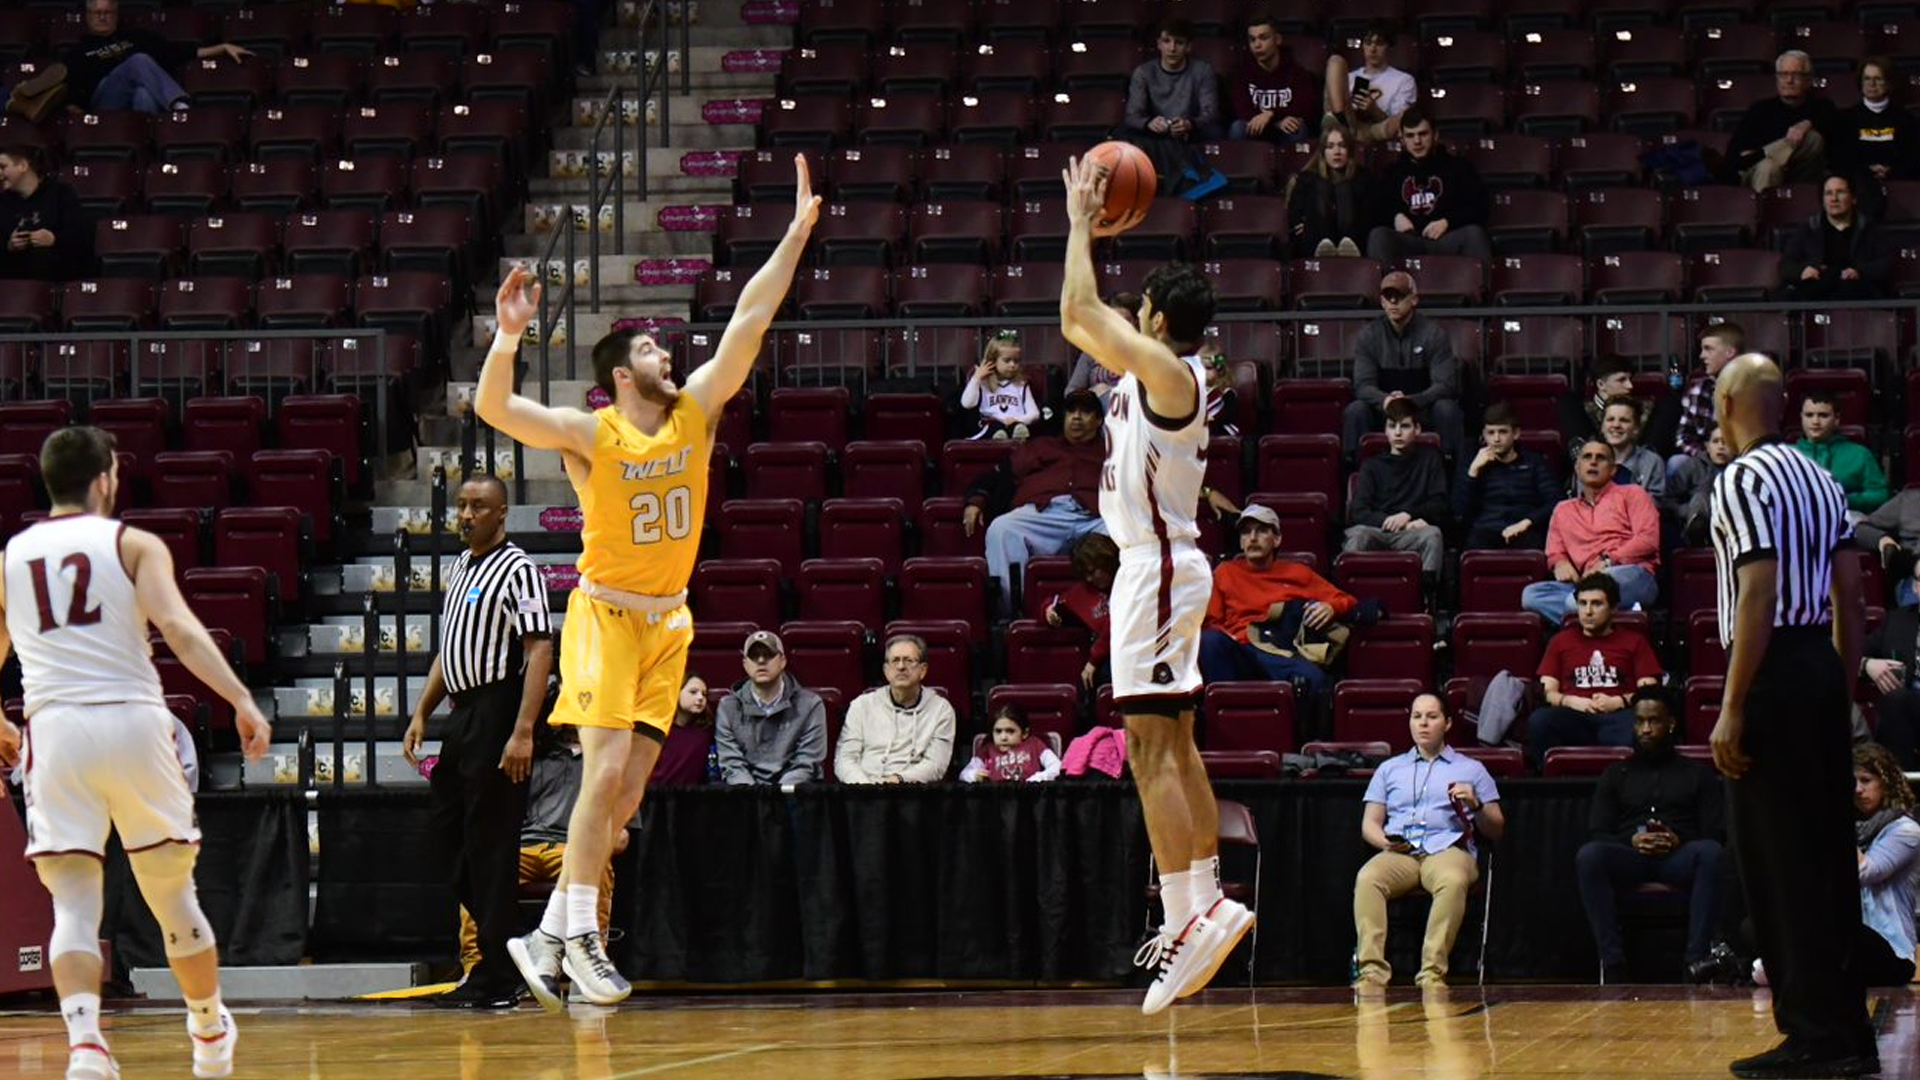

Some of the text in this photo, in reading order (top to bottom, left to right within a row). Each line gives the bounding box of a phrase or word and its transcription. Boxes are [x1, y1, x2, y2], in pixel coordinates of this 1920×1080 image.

[620, 447, 693, 480] WCU
[629, 485, 692, 545] 20
[26, 552, 103, 634] 12
